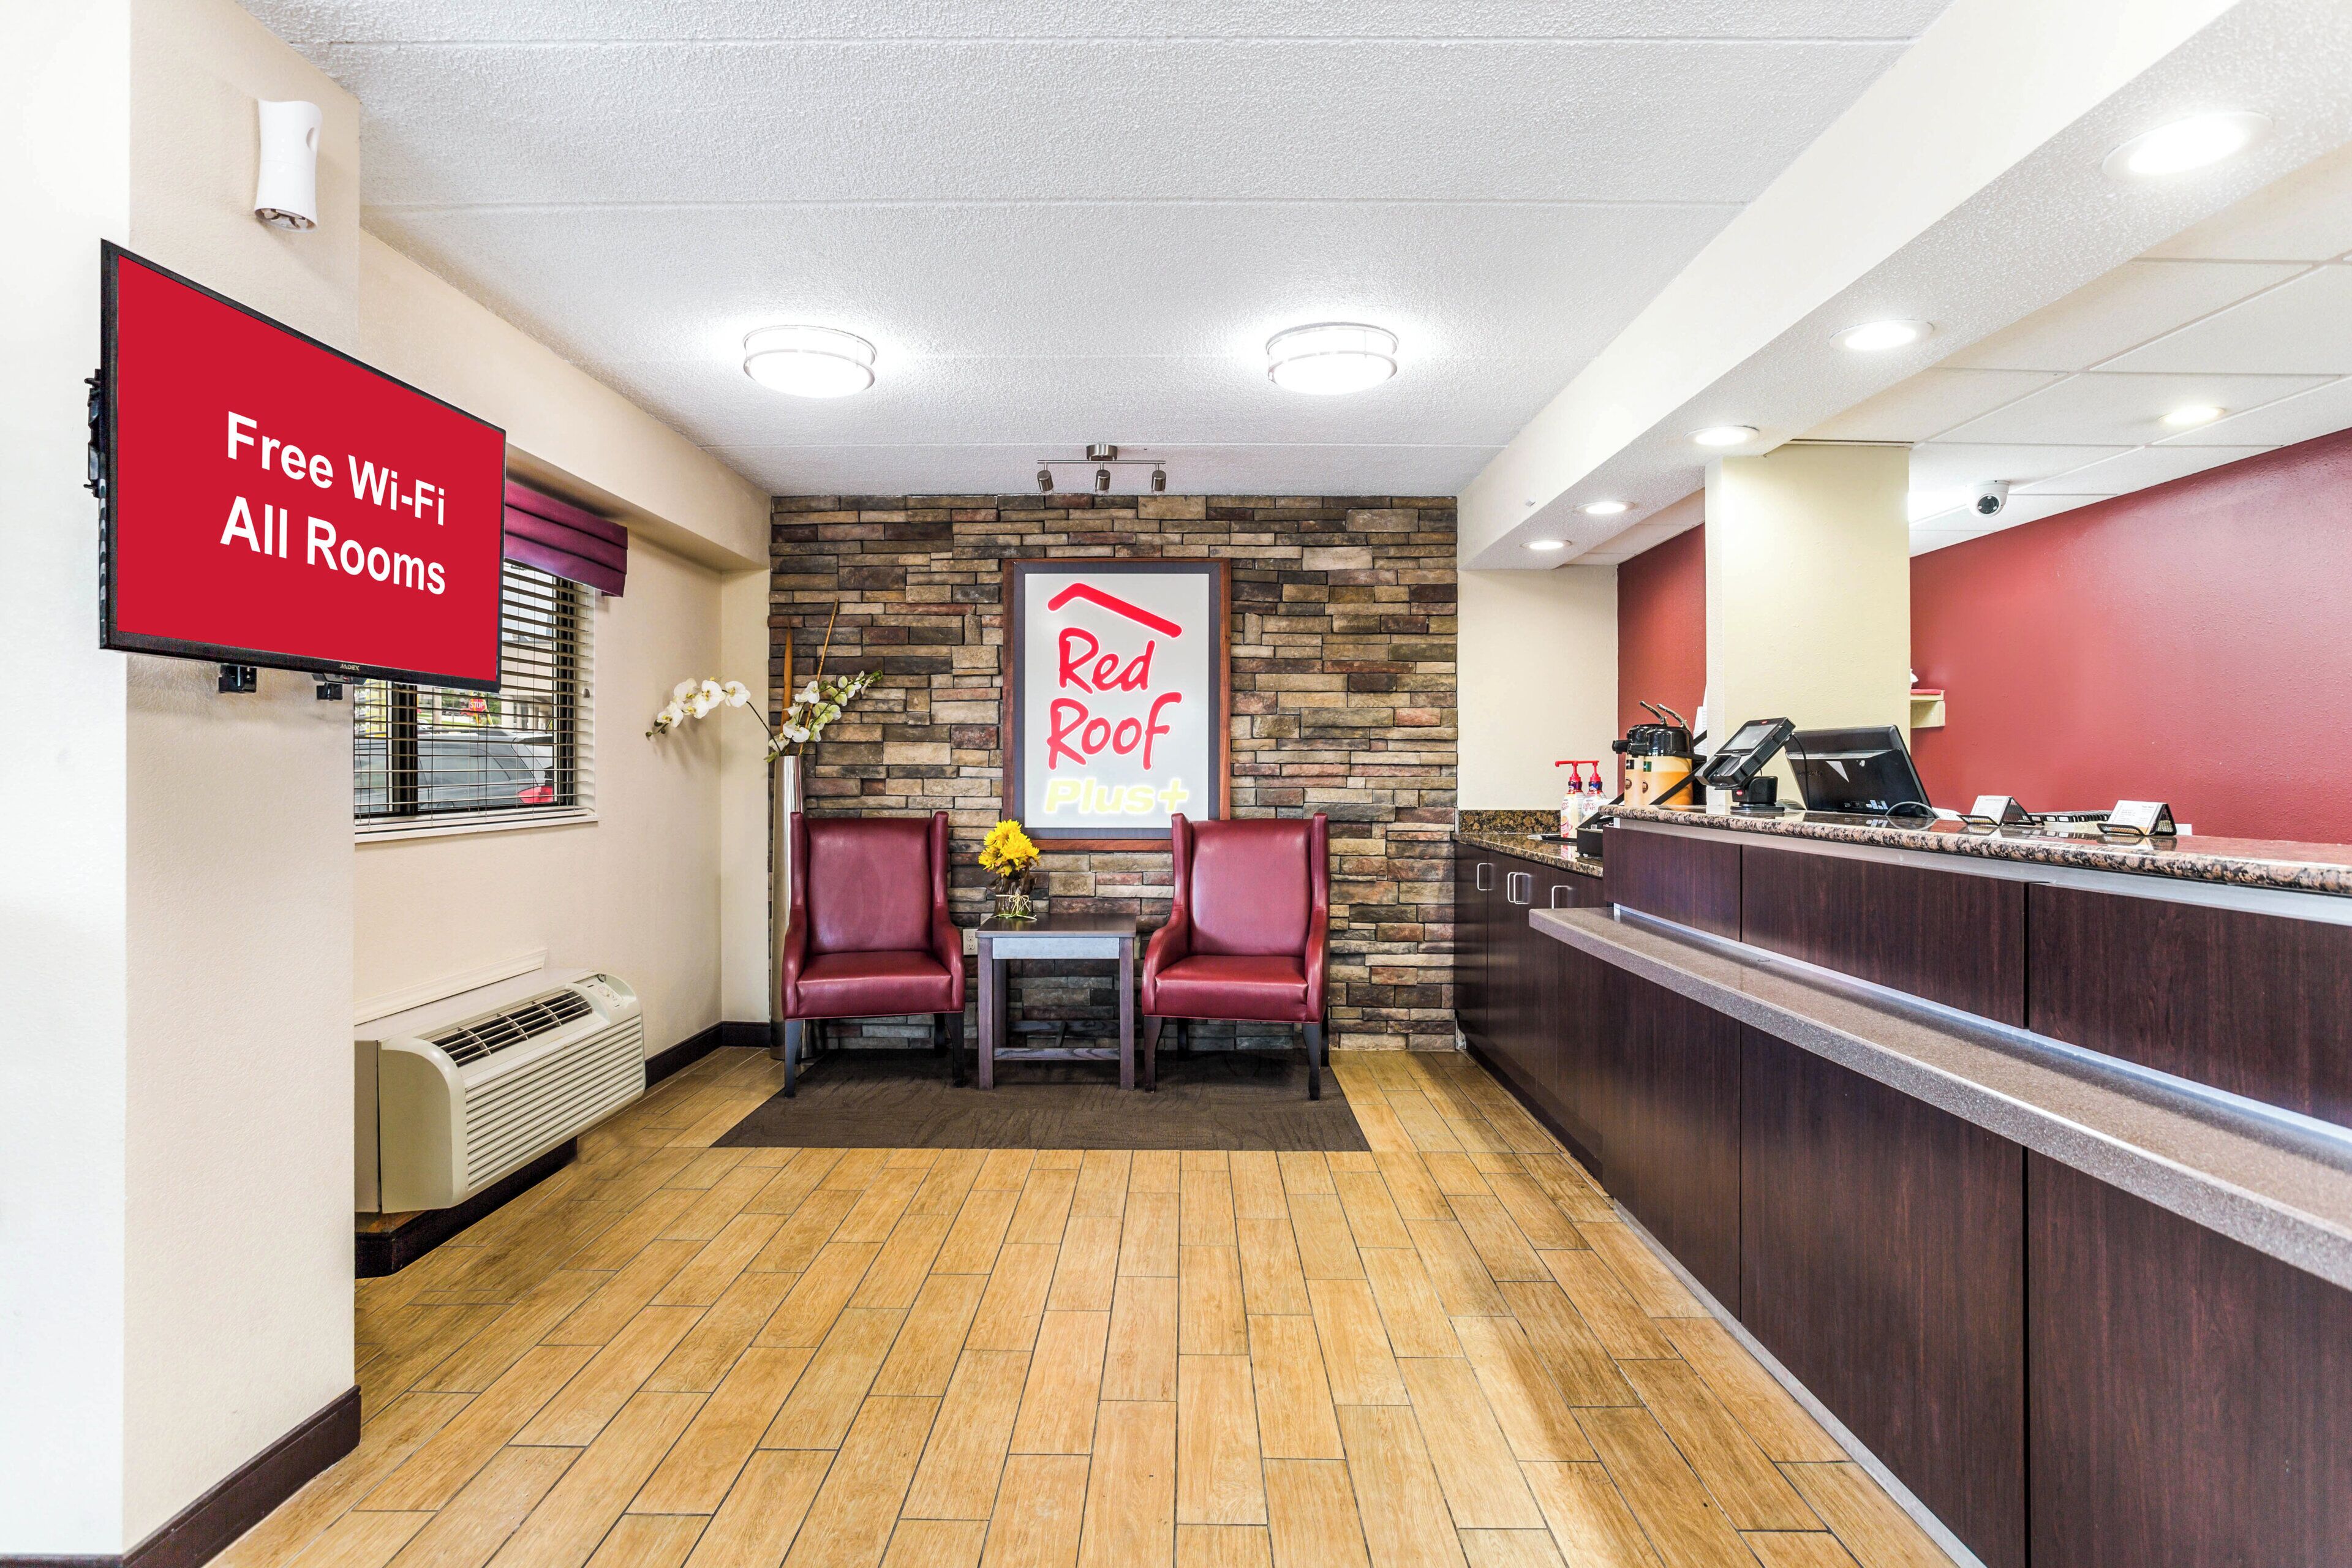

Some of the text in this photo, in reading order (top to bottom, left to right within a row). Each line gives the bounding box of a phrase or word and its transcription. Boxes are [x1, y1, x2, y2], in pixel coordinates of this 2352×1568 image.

[227, 410, 445, 526] Free Wi-Fi
[220, 496, 445, 595] All Rooms
[1058, 627, 1156, 695] Red
[1046, 692, 1183, 771] Roof
[1045, 779, 1188, 813] Plus+
